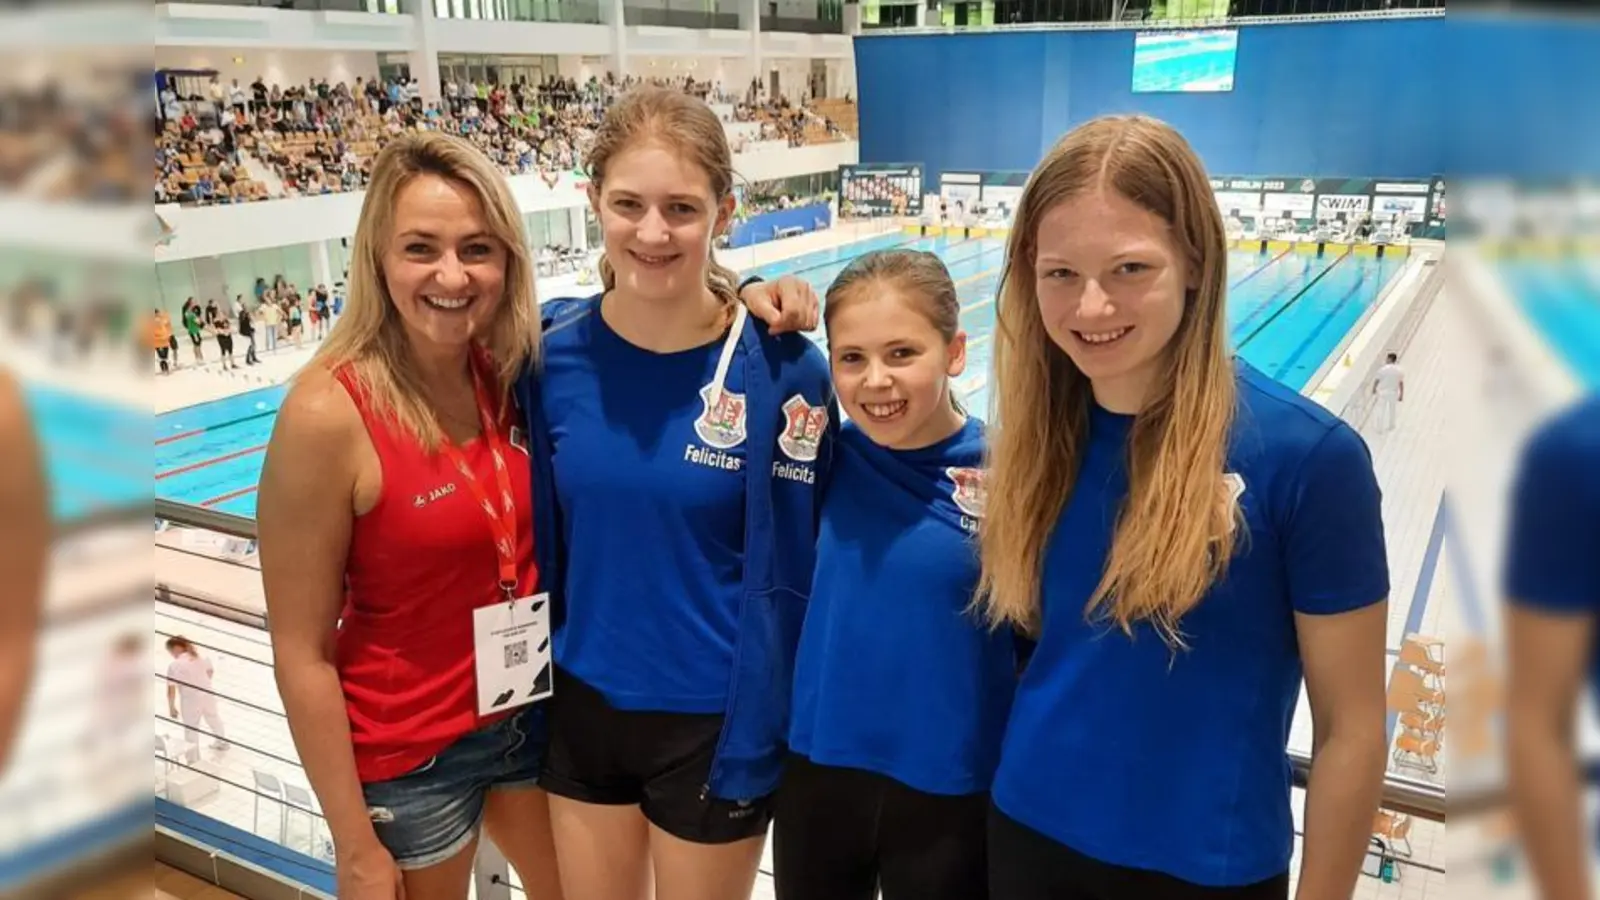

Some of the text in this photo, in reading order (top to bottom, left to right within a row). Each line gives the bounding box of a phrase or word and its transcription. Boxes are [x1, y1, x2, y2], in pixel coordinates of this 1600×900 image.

[1231, 180, 1262, 189] BERLIN
[684, 443, 741, 471] Felicitas
[426, 482, 457, 501] JAKO
